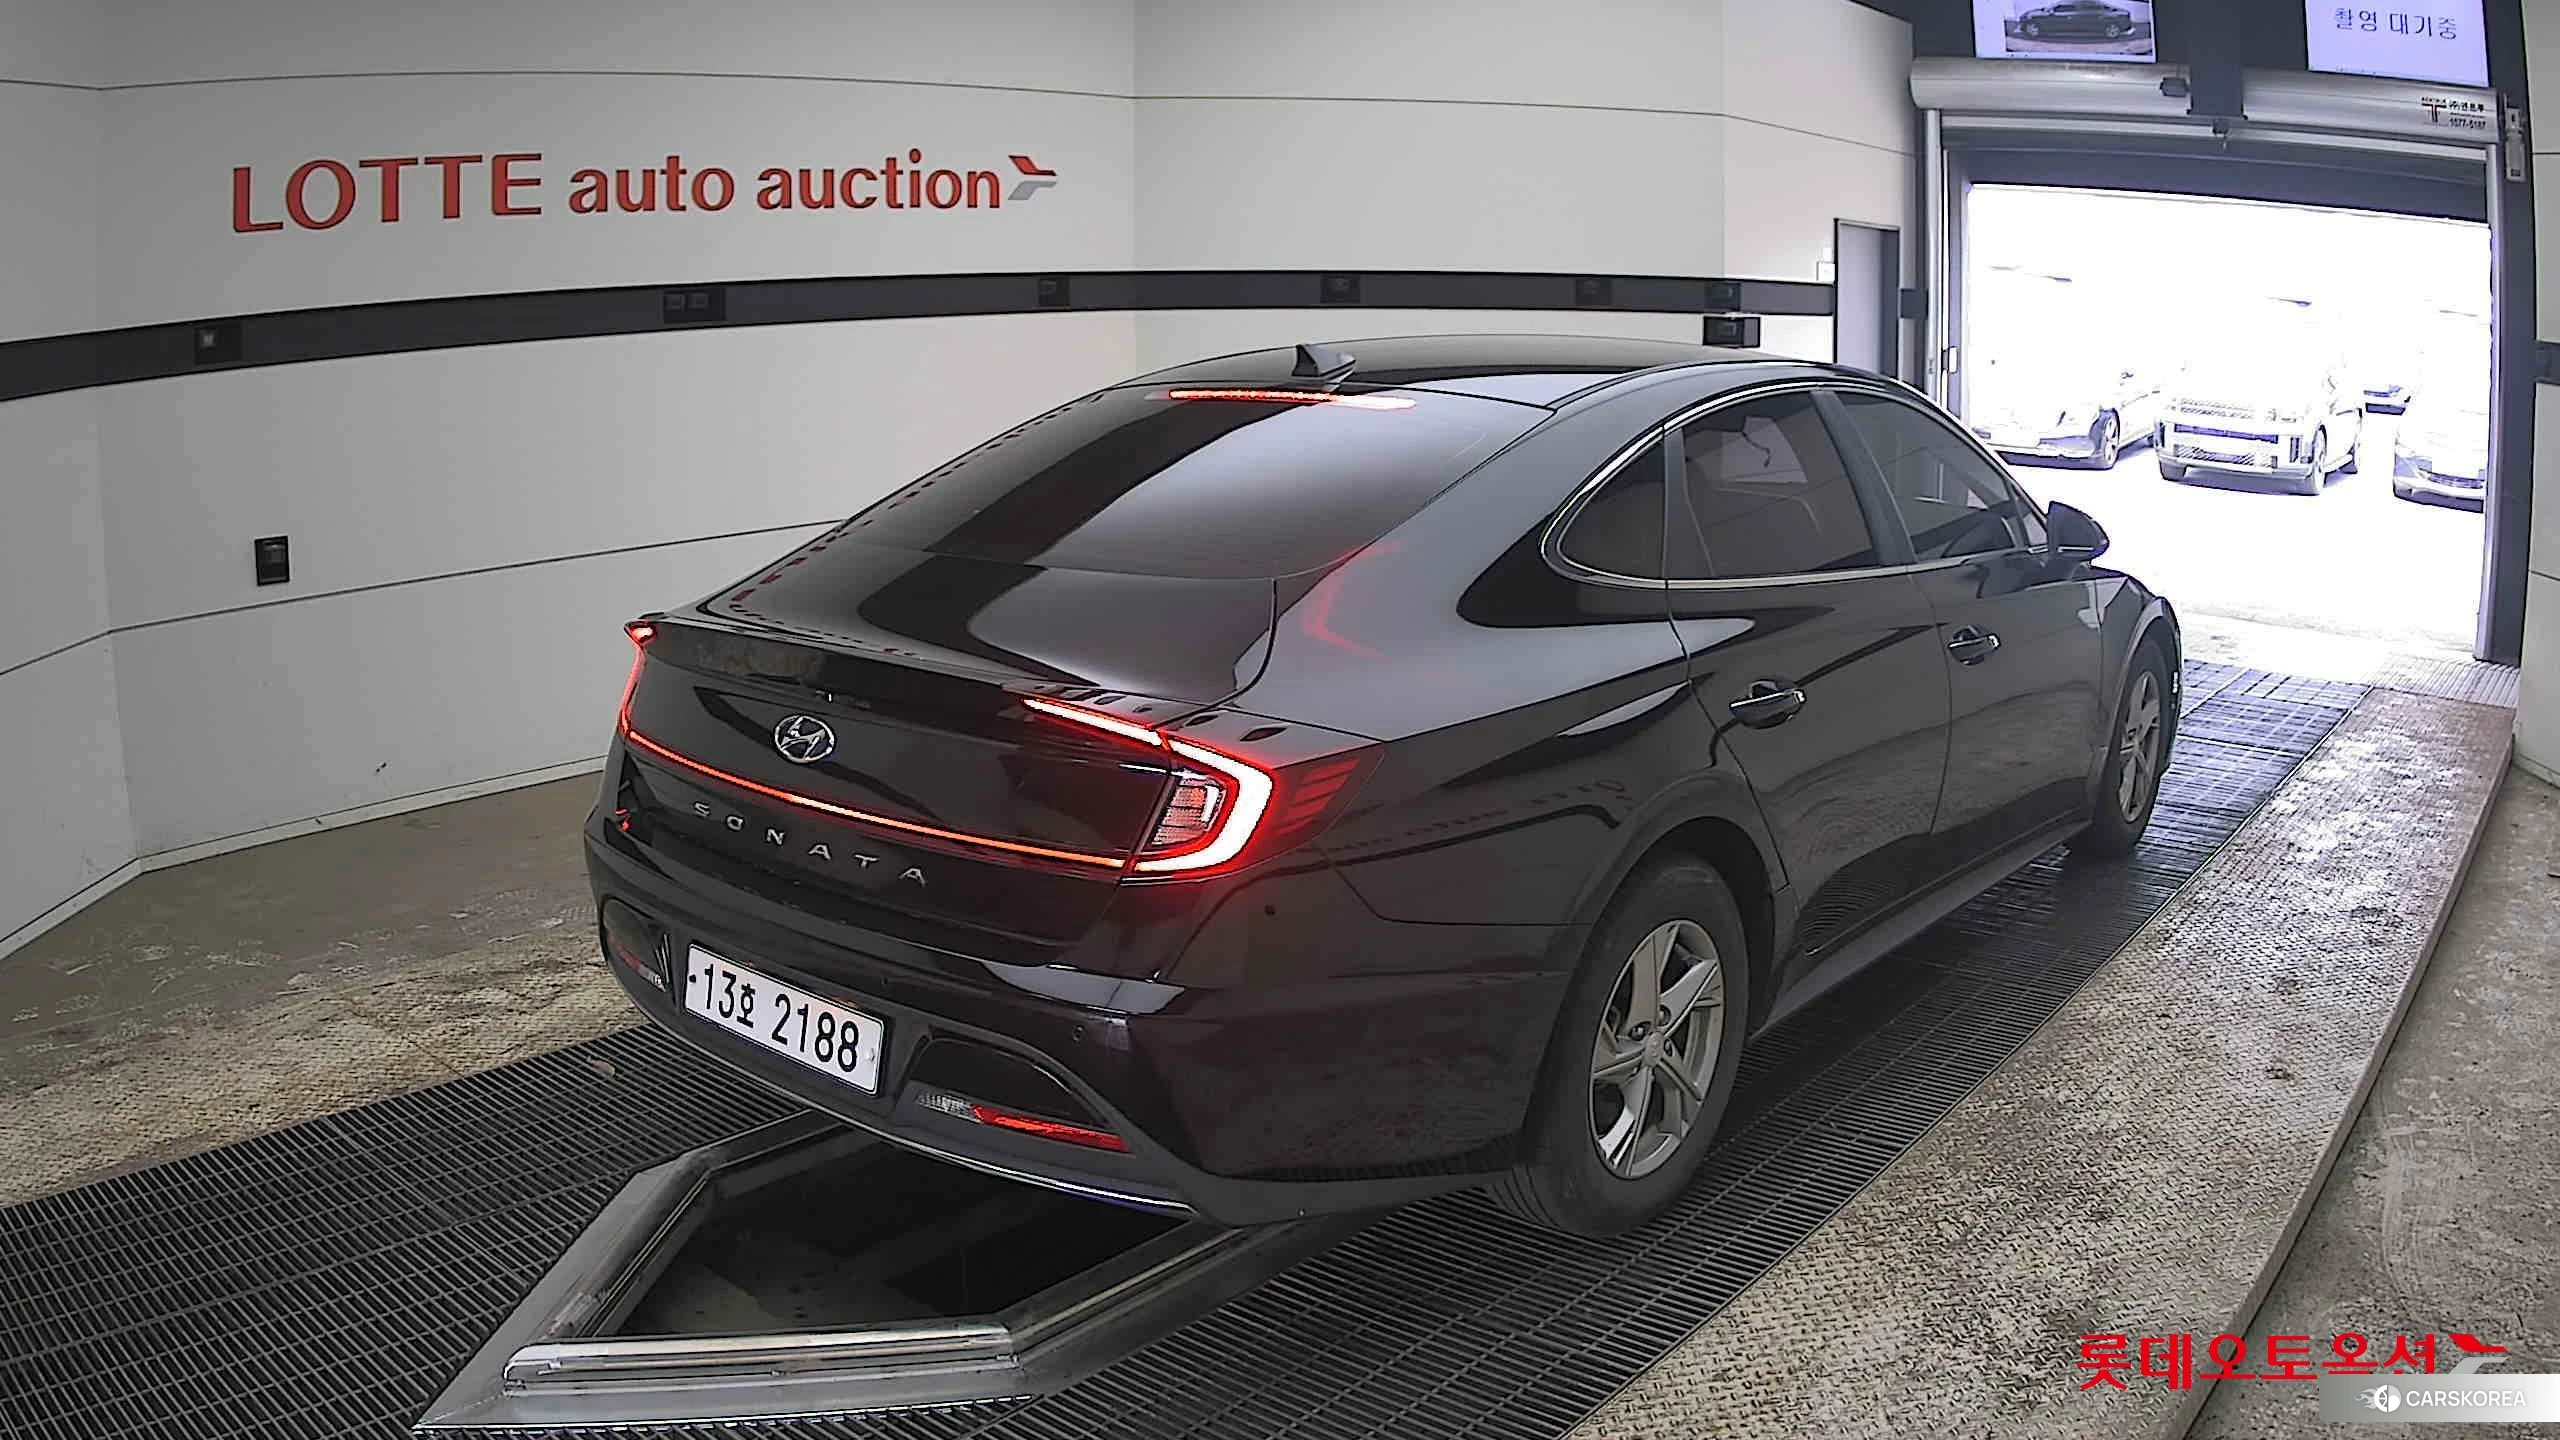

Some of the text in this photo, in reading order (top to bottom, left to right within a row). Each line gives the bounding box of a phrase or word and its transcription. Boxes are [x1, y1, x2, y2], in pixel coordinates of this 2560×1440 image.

[2389, 12, 2457, 40] 대기중
[232, 147, 1001, 233] LOTTE auto auction
[693, 801, 928, 888] SONATA
[704, 963, 860, 1073] 13호 2188
